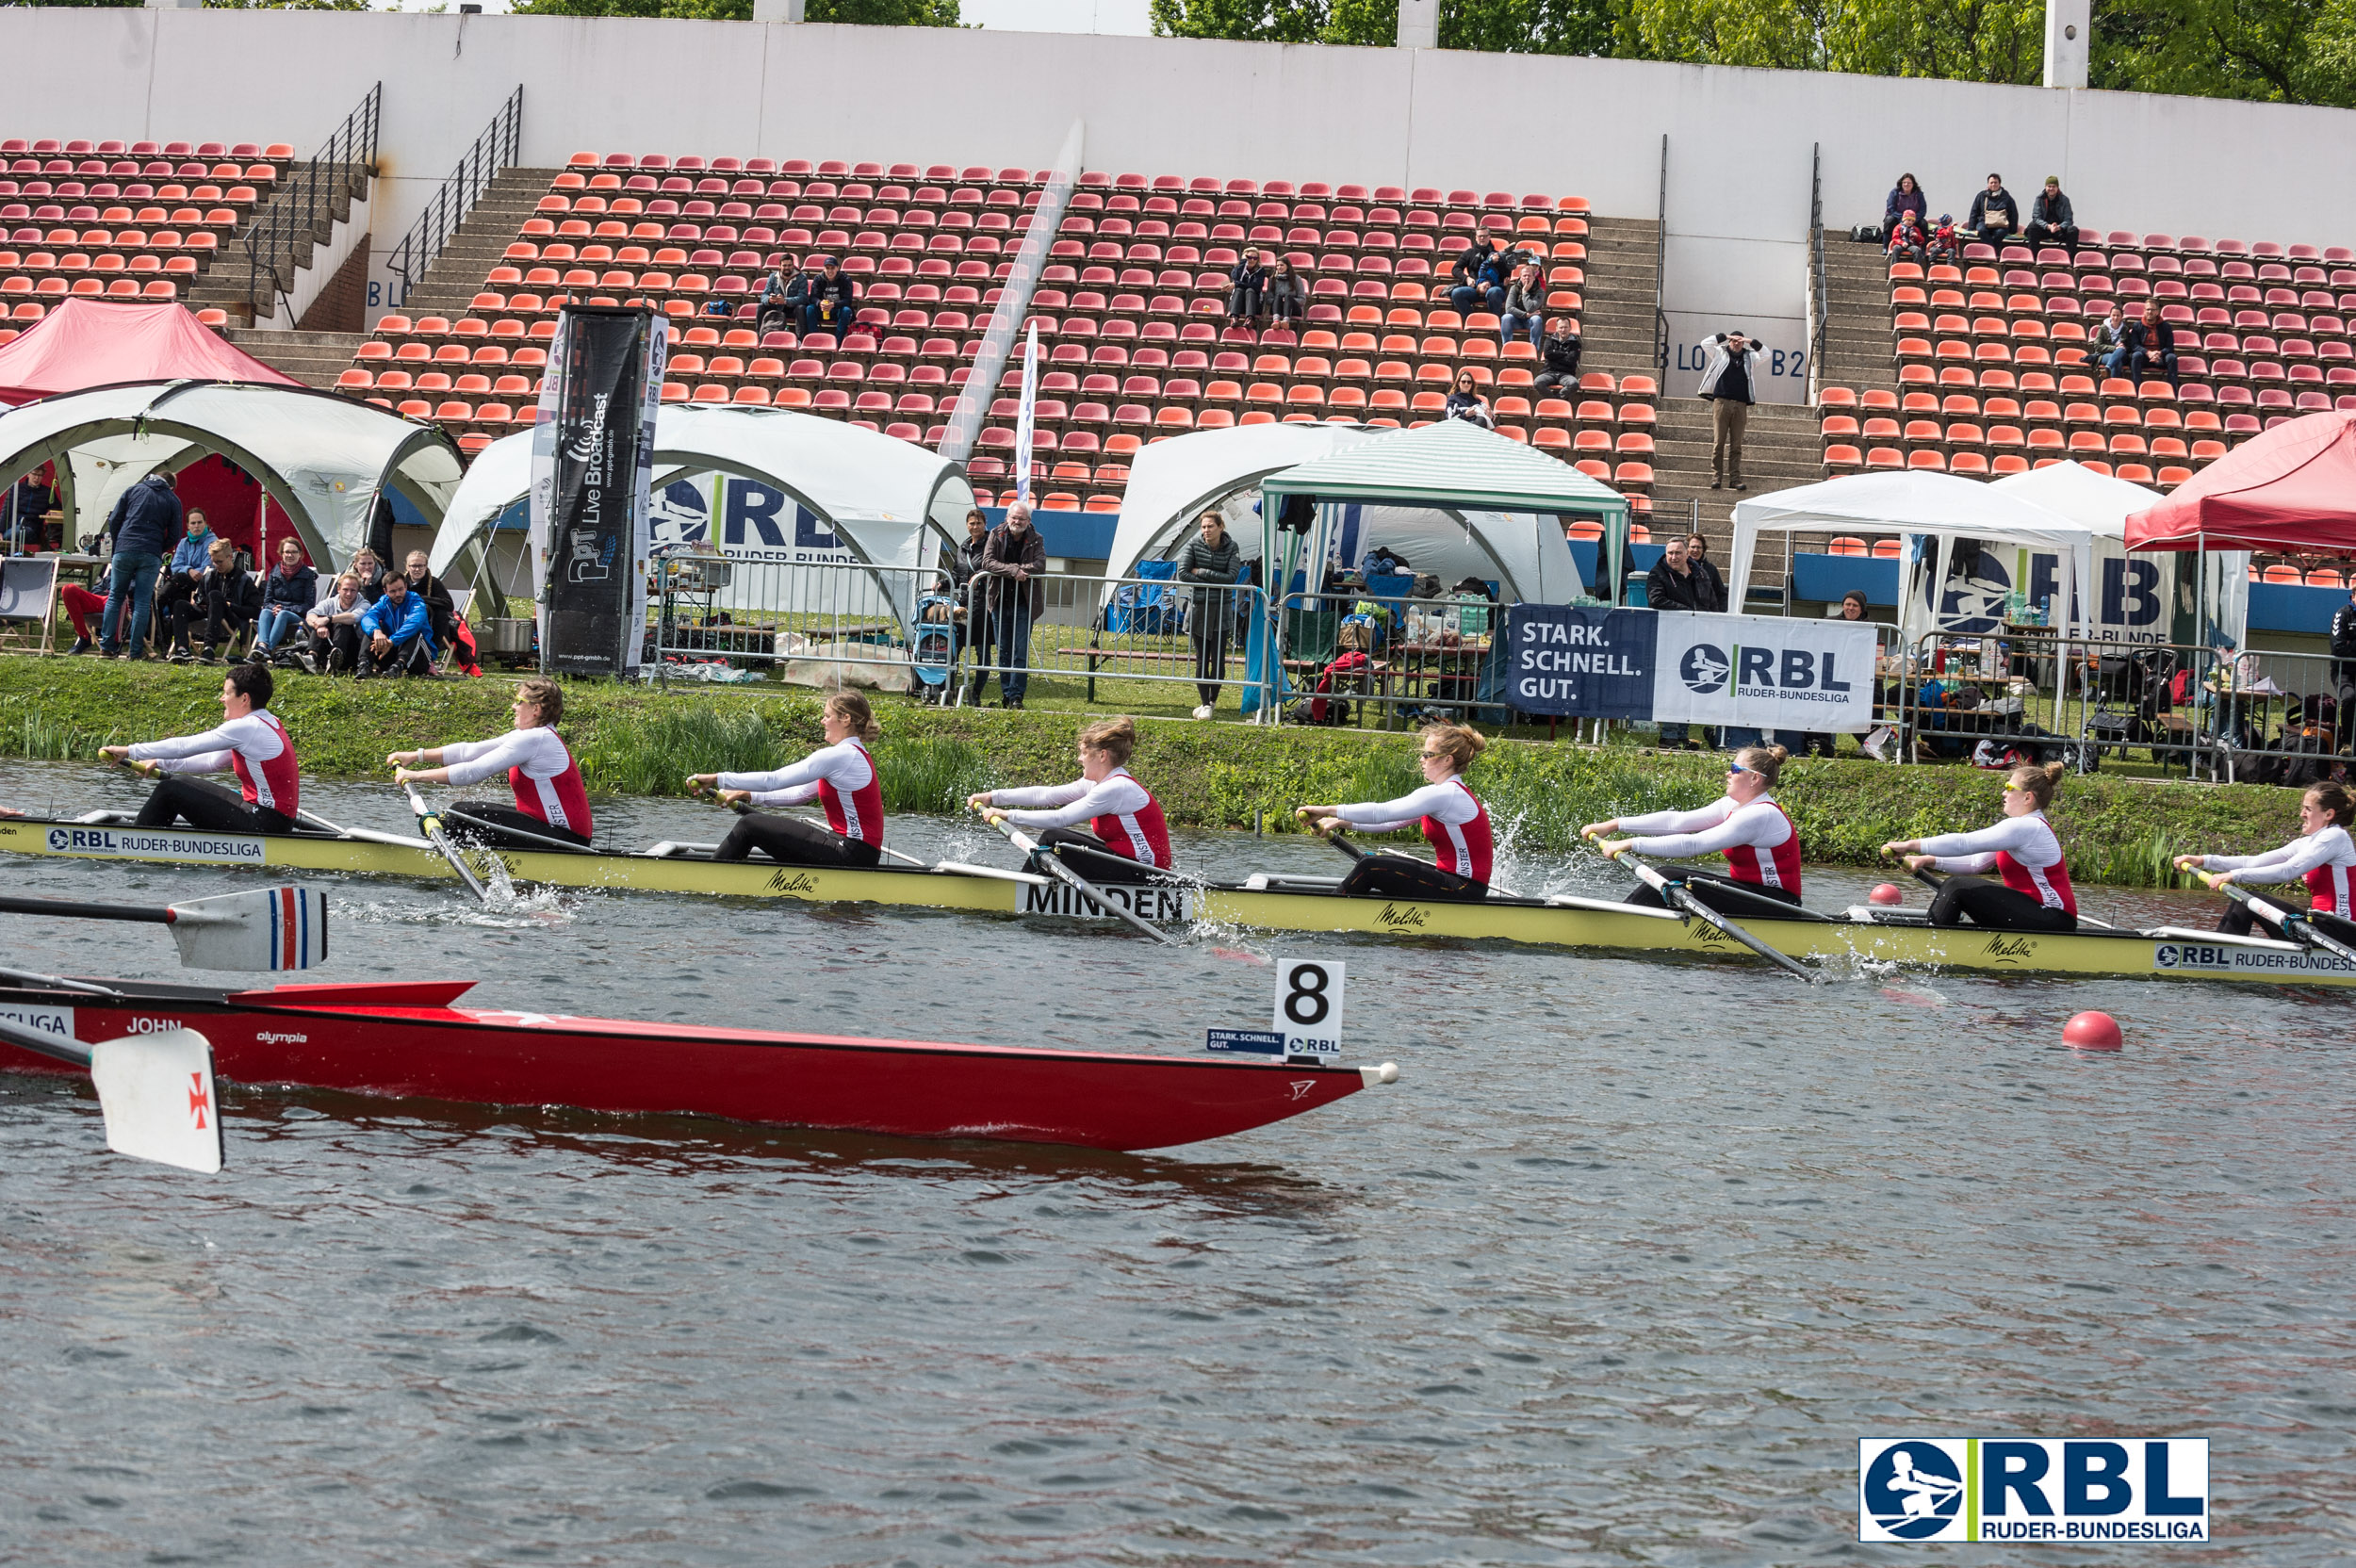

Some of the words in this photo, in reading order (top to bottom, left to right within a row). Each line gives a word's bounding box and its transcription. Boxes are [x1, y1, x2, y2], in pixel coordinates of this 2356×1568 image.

[584, 392, 608, 486] Broadcast
[606, 429, 614, 488] www.ppt-gmbh.de
[582, 488, 601, 524] Live
[1522, 622, 1610, 647] STARK.
[558, 653, 611, 662] www.ppt-gmbh.de
[1521, 650, 1642, 677] SCHNELL.
[1738, 646, 1851, 692] RBL
[1519, 678, 1577, 700] GUT.
[1738, 687, 1849, 704] RUDER-BUNDESLIGA
[73, 830, 117, 848] RBL
[122, 836, 262, 857] RUDER-BUNDESLIGA
[1026, 882, 1183, 920] MINDEN
[2183, 946, 2230, 965] RBL
[1284, 963, 1329, 1025] 8
[126, 1017, 182, 1034] JOHN
[256, 1031, 307, 1044] olympia
[1210, 1032, 1239, 1041] STARK.
[1240, 1034, 1280, 1044] SCHNELL.
[1210, 1040, 1229, 1049] GUT.
[1306, 1038, 1340, 1053] RBL
